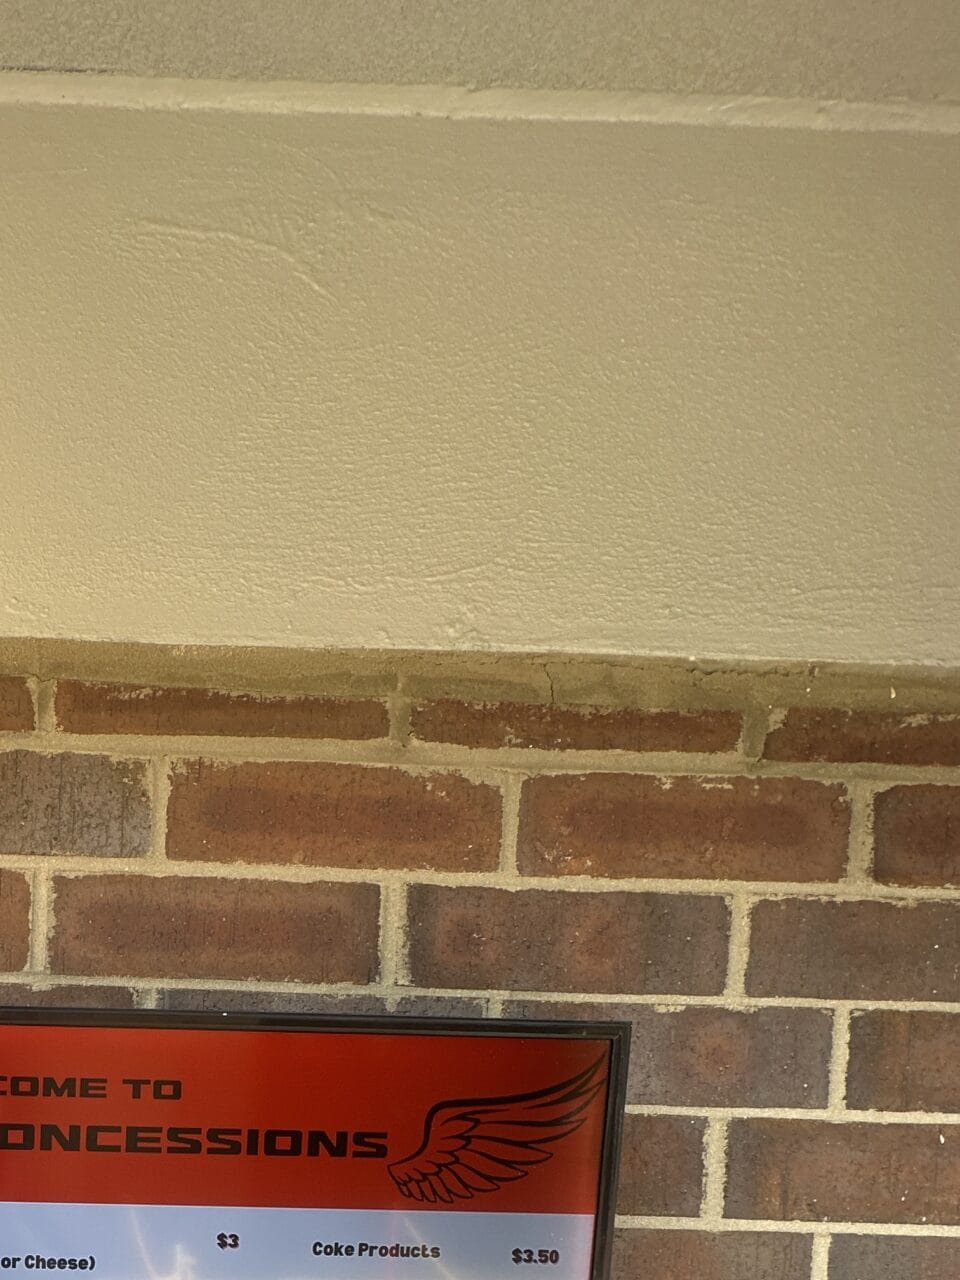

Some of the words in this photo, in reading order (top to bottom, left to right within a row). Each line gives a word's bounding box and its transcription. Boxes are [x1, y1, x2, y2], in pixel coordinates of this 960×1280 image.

[124, 1079, 181, 1100] TO
[216, 1233, 240, 1249] $3
[312, 1242, 355, 1256] Coke
[358, 1243, 440, 1258] Products
[511, 1248, 559, 1264] $3.50
[1, 1257, 21, 1268] or
[24, 1255, 96, 1270] Cheese)
